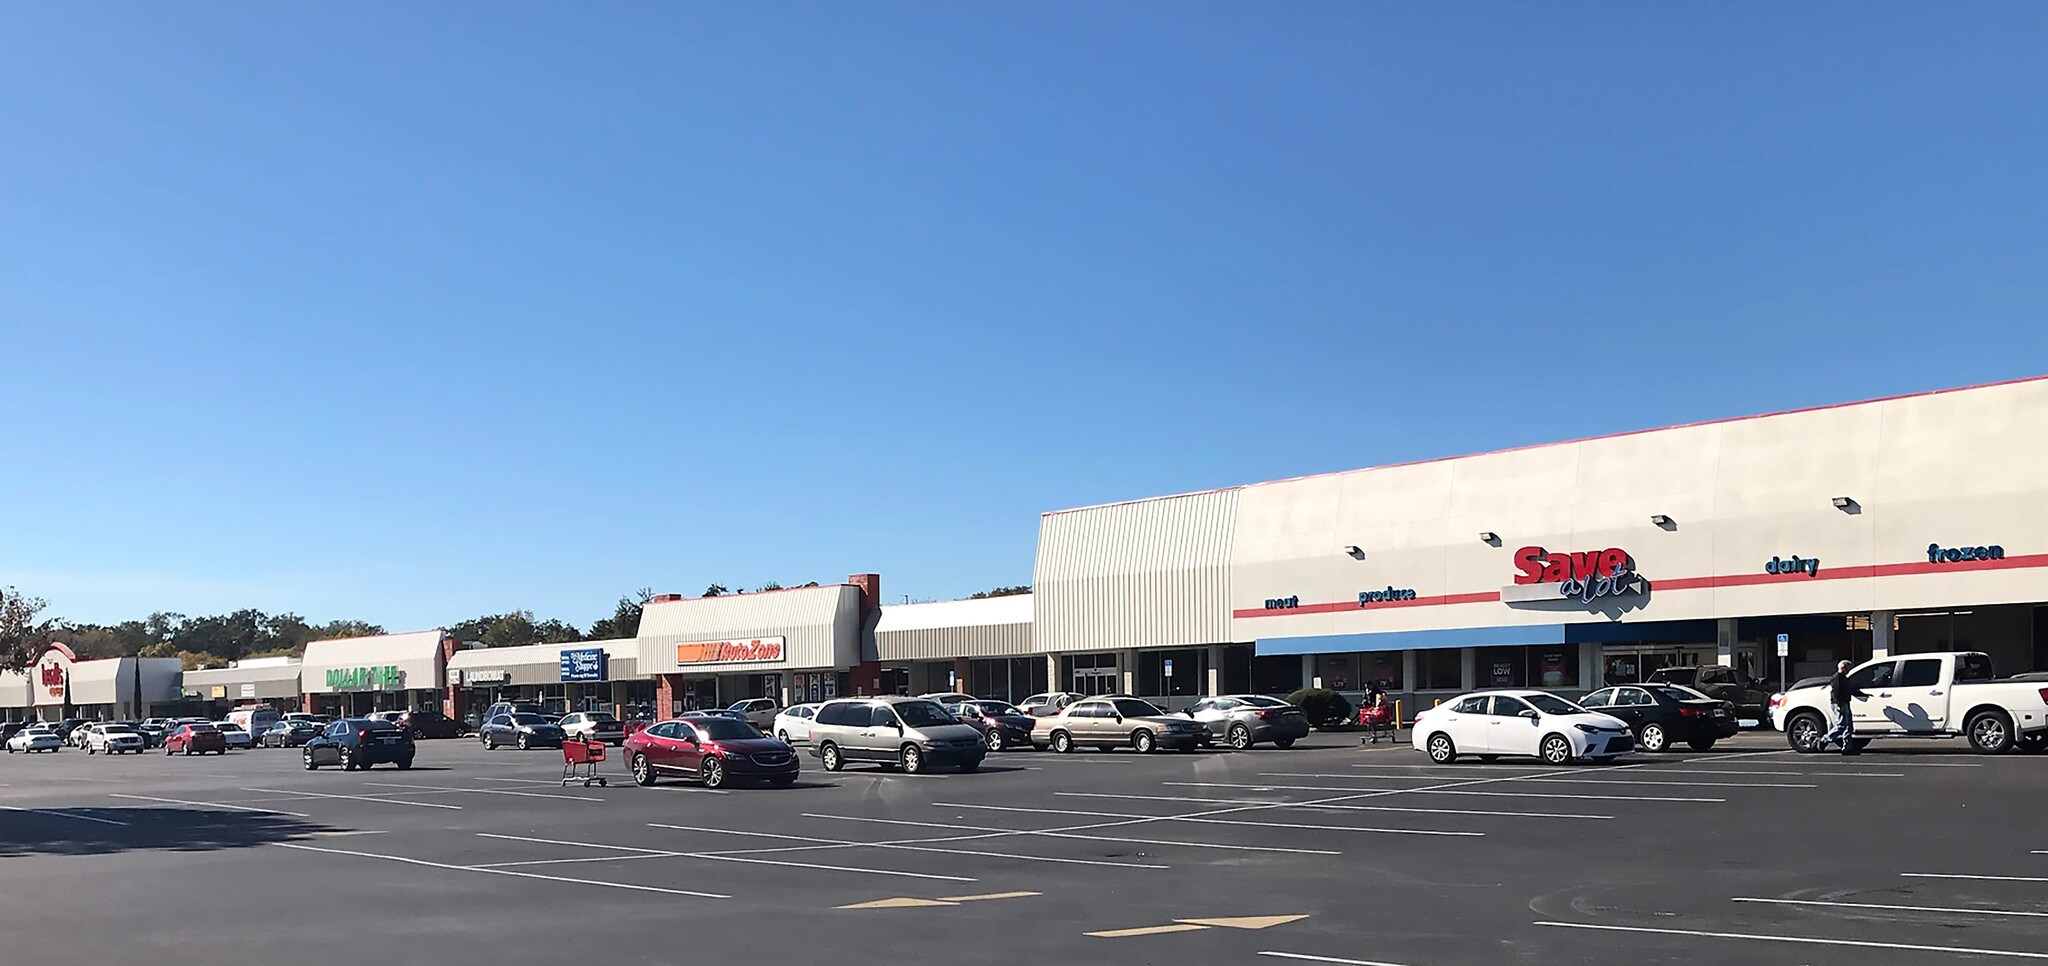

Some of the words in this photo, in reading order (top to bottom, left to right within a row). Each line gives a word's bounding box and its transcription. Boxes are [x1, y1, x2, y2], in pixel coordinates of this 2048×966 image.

[1927, 543, 2005, 563] frozen
[1514, 546, 1627, 585] Save
[1765, 555, 1819, 577] dairy
[1264, 595, 1299, 610] meat
[1358, 586, 1416, 607] produce
[720, 639, 781, 661] AutoZone
[325, 667, 367, 688] DOLLAR
[370, 665, 398, 686] TREE
[1493, 668, 1511, 676] LOW
